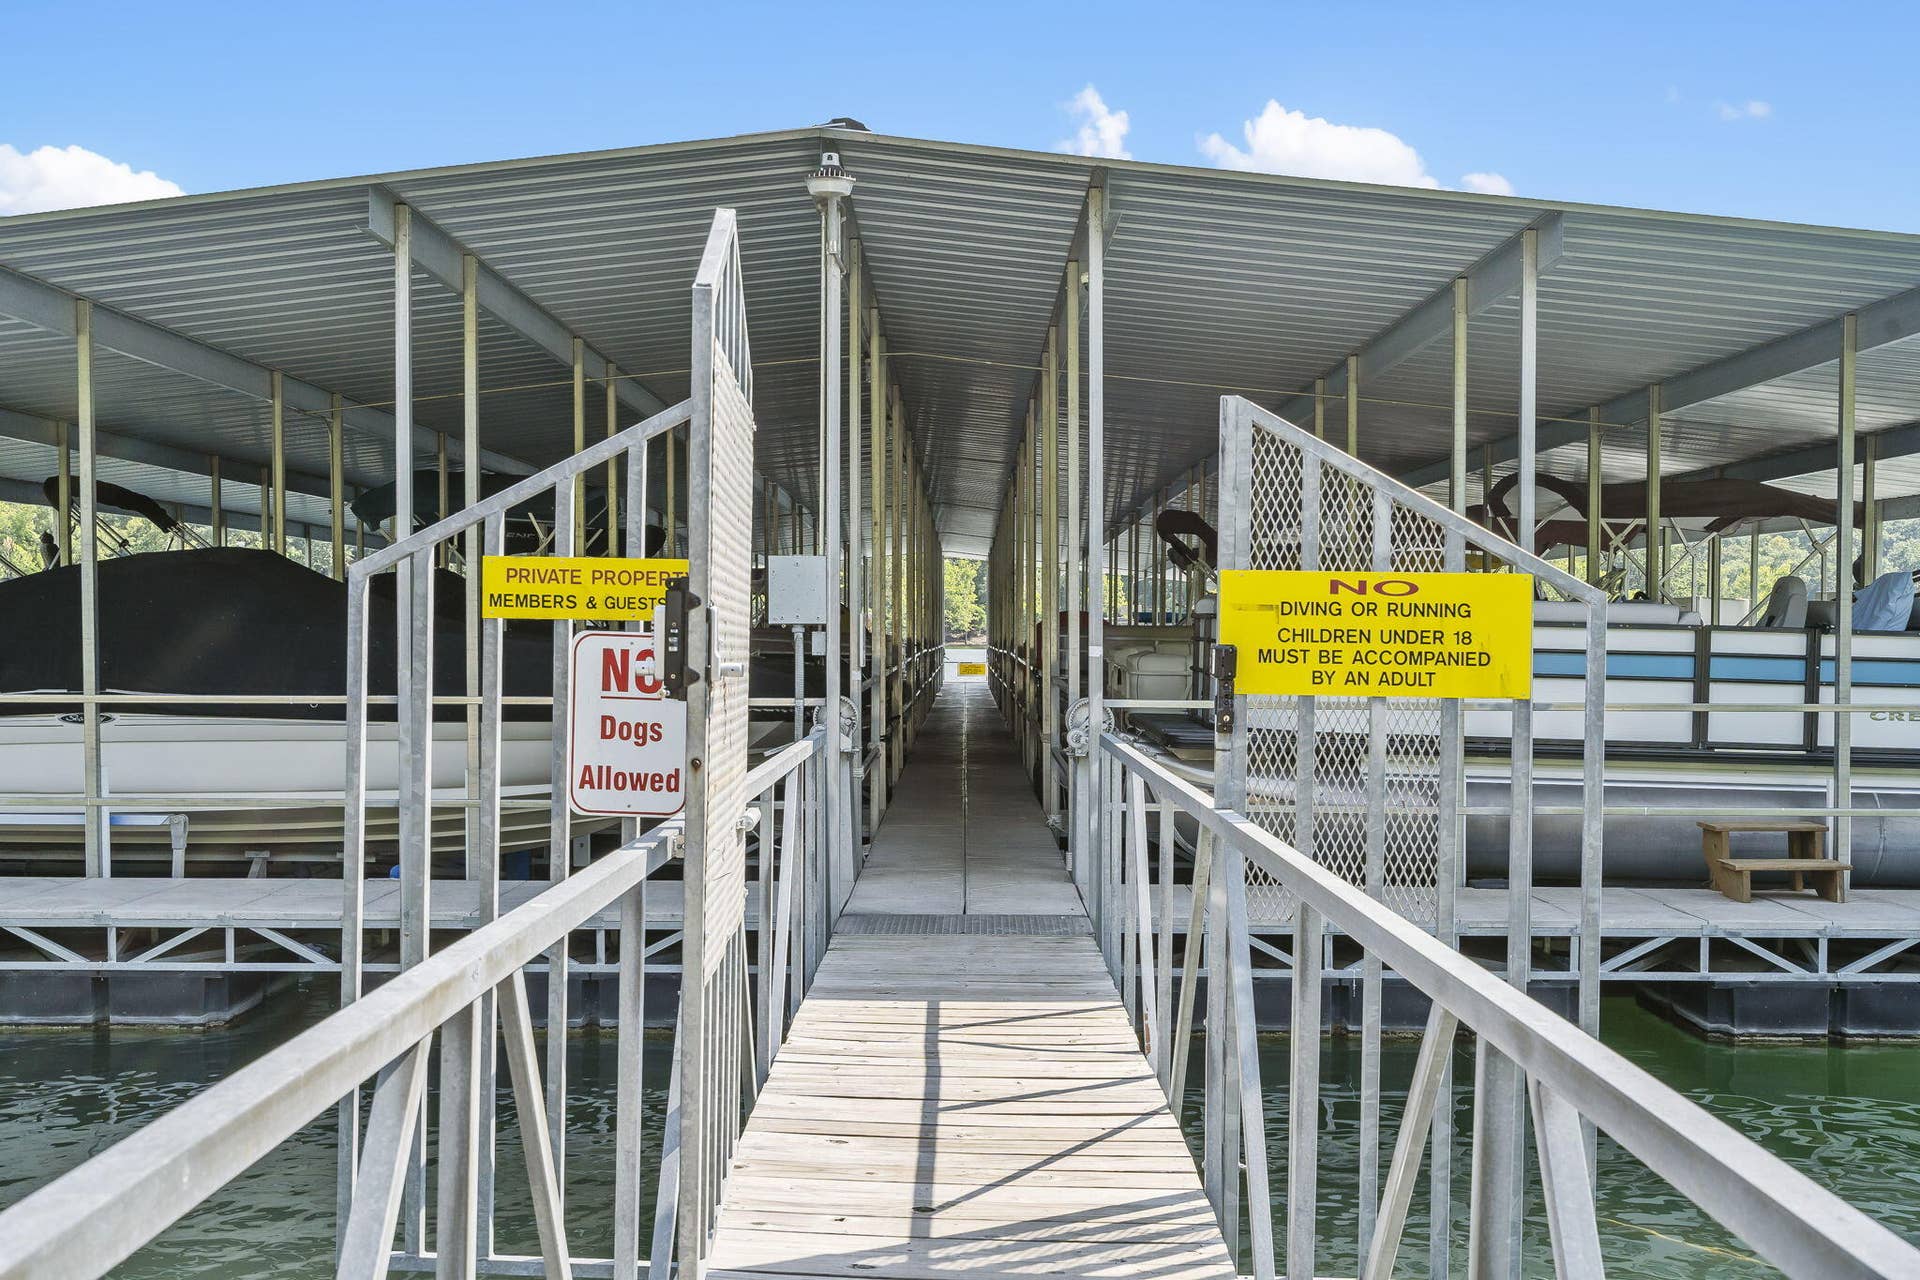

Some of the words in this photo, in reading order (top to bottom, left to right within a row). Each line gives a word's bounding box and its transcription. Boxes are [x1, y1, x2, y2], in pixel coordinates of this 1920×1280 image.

[506, 567, 583, 585] PRIVATE
[591, 570, 688, 587] PROPER
[1330, 579, 1419, 597] NO
[489, 593, 577, 610] MEMBERS
[586, 596, 597, 610] &
[1280, 601, 1342, 617] DIVING
[1351, 602, 1378, 618] OR
[1387, 603, 1472, 619] RUNNING
[1277, 627, 1372, 644] CHILDREN
[1380, 630, 1445, 646] UNDER
[1453, 631, 1473, 646] 18
[1258, 649, 1310, 665] MUST
[1319, 650, 1344, 666] BE
[1352, 651, 1491, 668] ACCOMPANIED
[1312, 670, 1335, 686] BY
[1344, 671, 1370, 687] AN
[1378, 672, 1437, 688] ADULT
[600, 715, 664, 748] Dogs
[578, 764, 681, 794] Allowed
